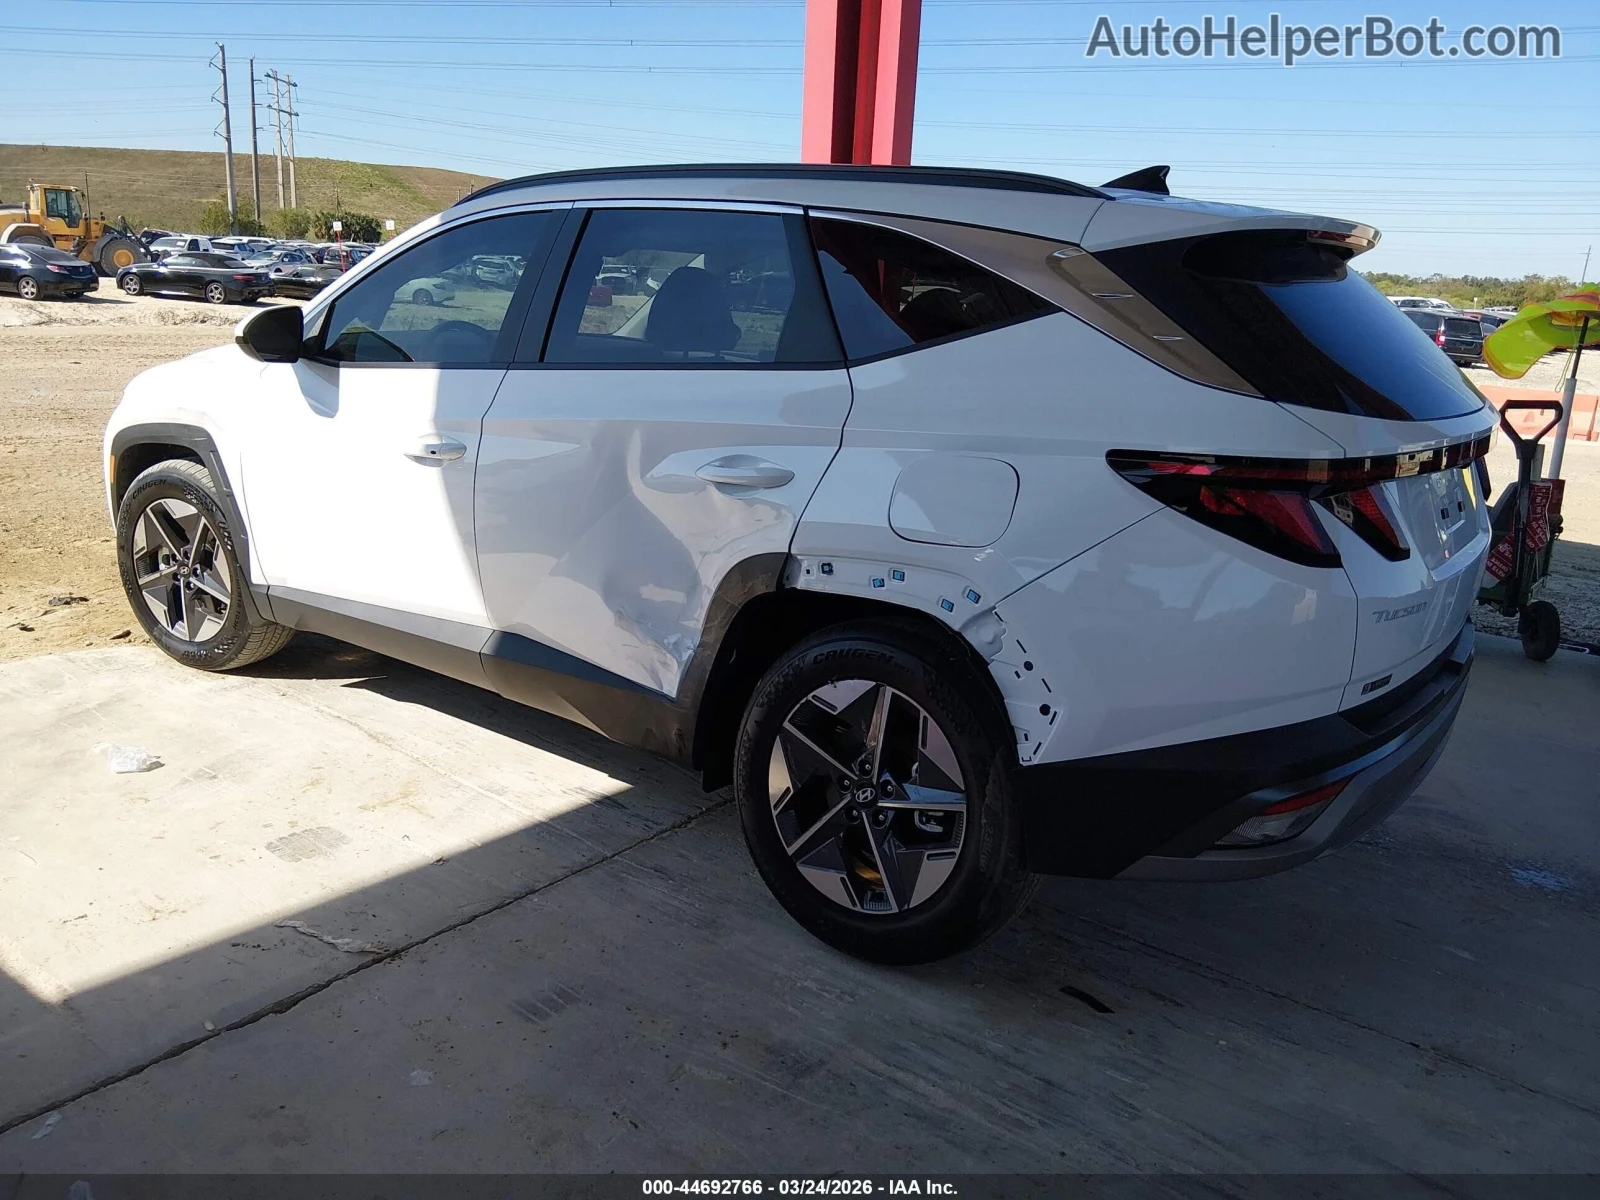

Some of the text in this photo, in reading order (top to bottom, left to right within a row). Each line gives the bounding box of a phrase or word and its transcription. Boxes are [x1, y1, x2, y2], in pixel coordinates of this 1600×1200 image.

[132, 479, 167, 500] CRUGEN
[1372, 601, 1427, 624] TUCSON
[813, 648, 895, 665] CRUGEN
